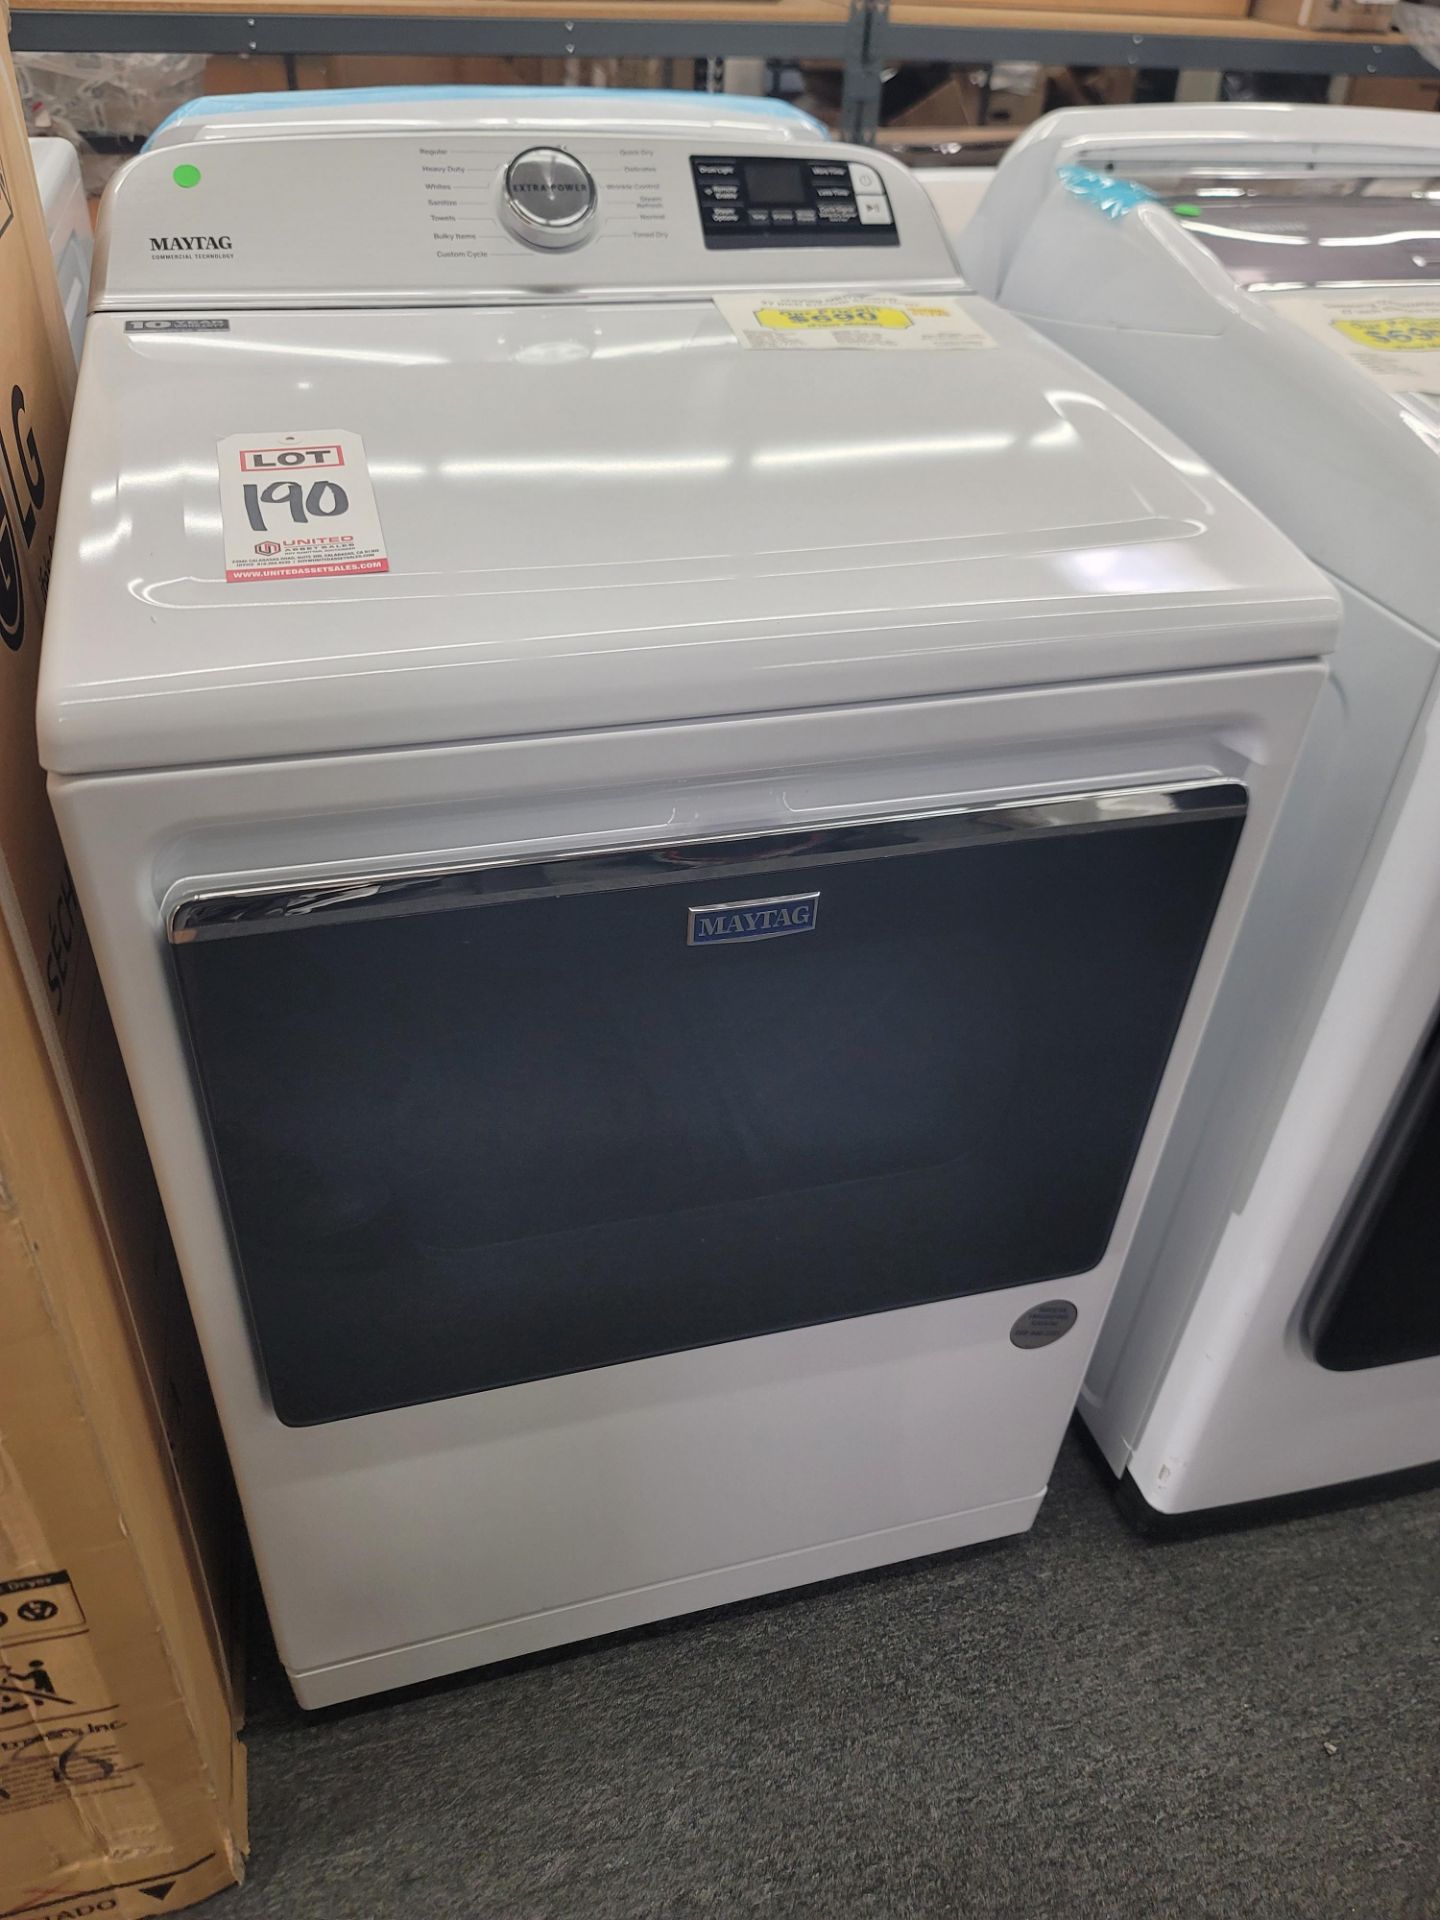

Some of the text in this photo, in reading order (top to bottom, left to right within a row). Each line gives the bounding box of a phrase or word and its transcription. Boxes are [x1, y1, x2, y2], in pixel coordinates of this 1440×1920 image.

[512, 183, 588, 192] EXTRA POWER
[149, 236, 232, 251] MAYTAG
[0, 384, 45, 549] LG
[254, 450, 331, 467] LOT
[243, 480, 349, 532] 190
[283, 535, 353, 545] UNITED
[233, 561, 382, 579] WWW.UNITEDASSETSALES.COM
[698, 905, 810, 937] MAYTAG
[44, 1898, 117, 1920] ADO
